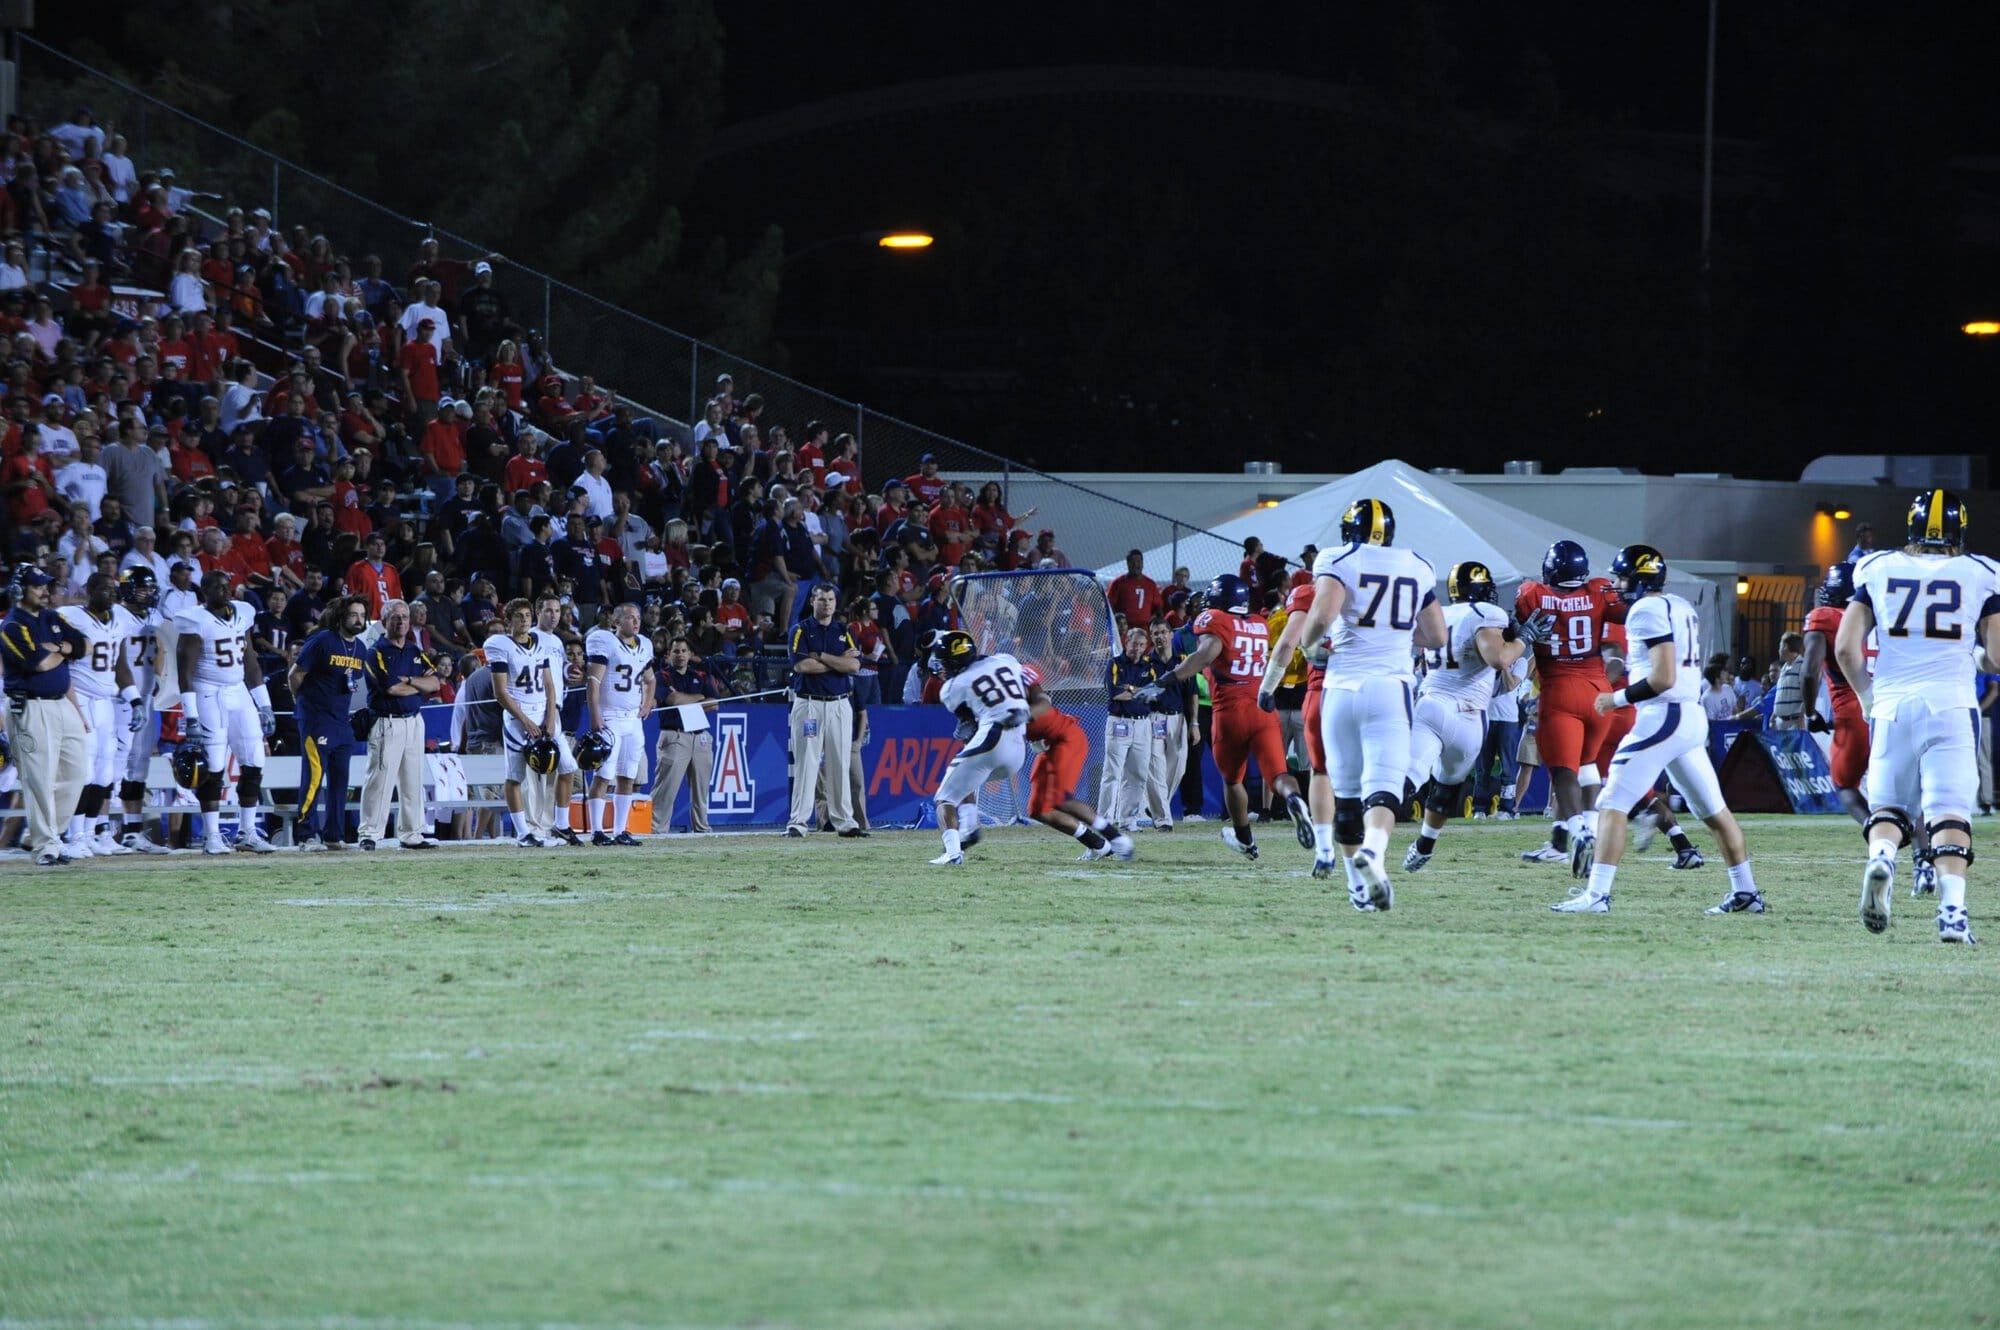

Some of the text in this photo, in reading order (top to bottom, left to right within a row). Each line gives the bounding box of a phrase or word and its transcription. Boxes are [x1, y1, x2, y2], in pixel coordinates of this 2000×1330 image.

[1469, 566, 1491, 584] Cal
[1636, 554, 1660, 574] Cal
[1135, 588, 1145, 609] 7
[1357, 573, 1418, 631] 70
[1541, 595, 1594, 612] MITCHELL
[1887, 577, 1962, 640] 72
[92, 641, 117, 672] 61
[214, 635, 245, 668] 53
[329, 655, 362, 670] FOOTBALL
[1230, 635, 1268, 677] 33
[515, 665, 545, 694] 40
[972, 666, 1024, 708] 86
[707, 712, 756, 814] A
[1770, 745, 1815, 770] Game
[1785, 775, 1837, 801] ponsor
